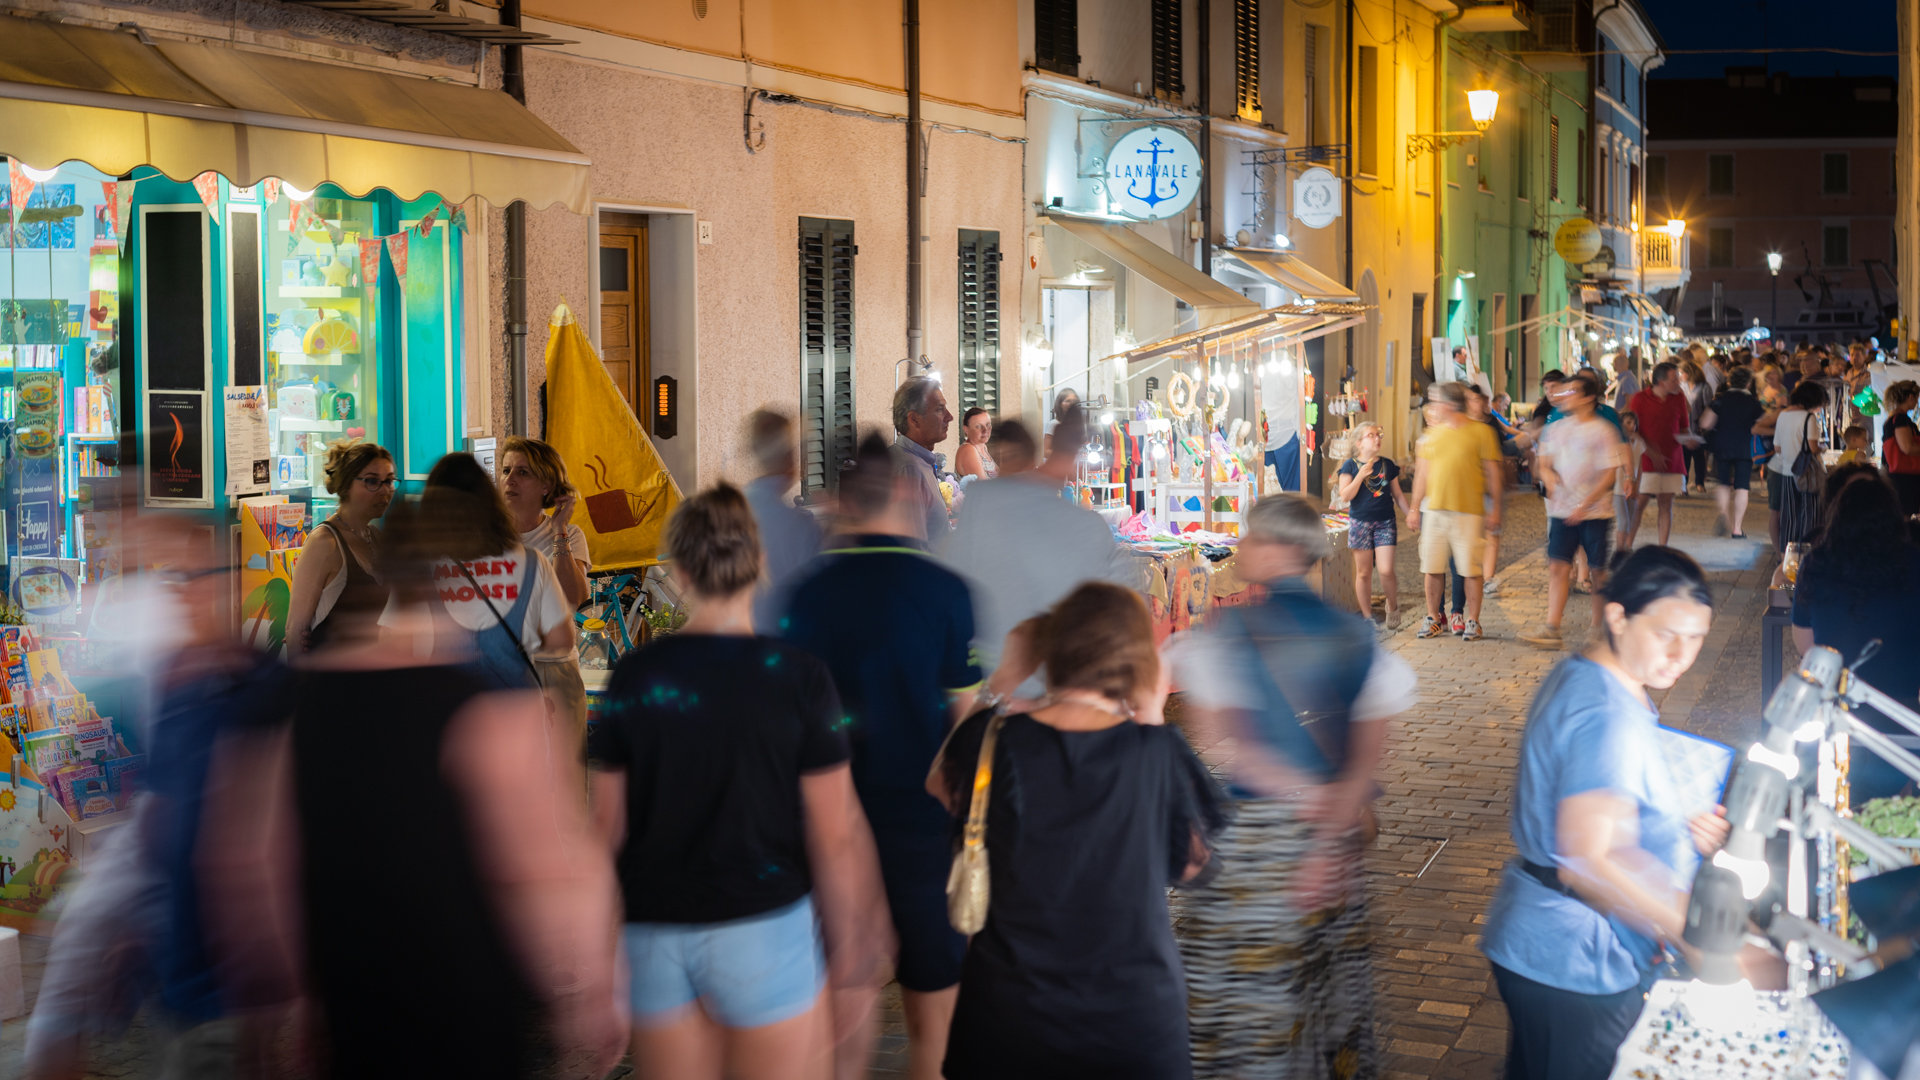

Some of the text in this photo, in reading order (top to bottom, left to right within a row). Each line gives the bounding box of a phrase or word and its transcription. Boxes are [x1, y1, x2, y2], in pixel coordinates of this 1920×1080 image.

[701, 225, 709, 239] 24
[18, 509, 48, 541] Happy
[433, 559, 518, 581] MICKEY
[438, 583, 518, 603] MOUSE
[9, 665, 24, 675] Comic
[2, 717, 16, 728] COLO
[75, 728, 109, 741] DINOSAURI
[49, 739, 71, 750] ALBUM
[44, 749, 74, 763] COLORARE
[84, 801, 112, 812] COLORANO
